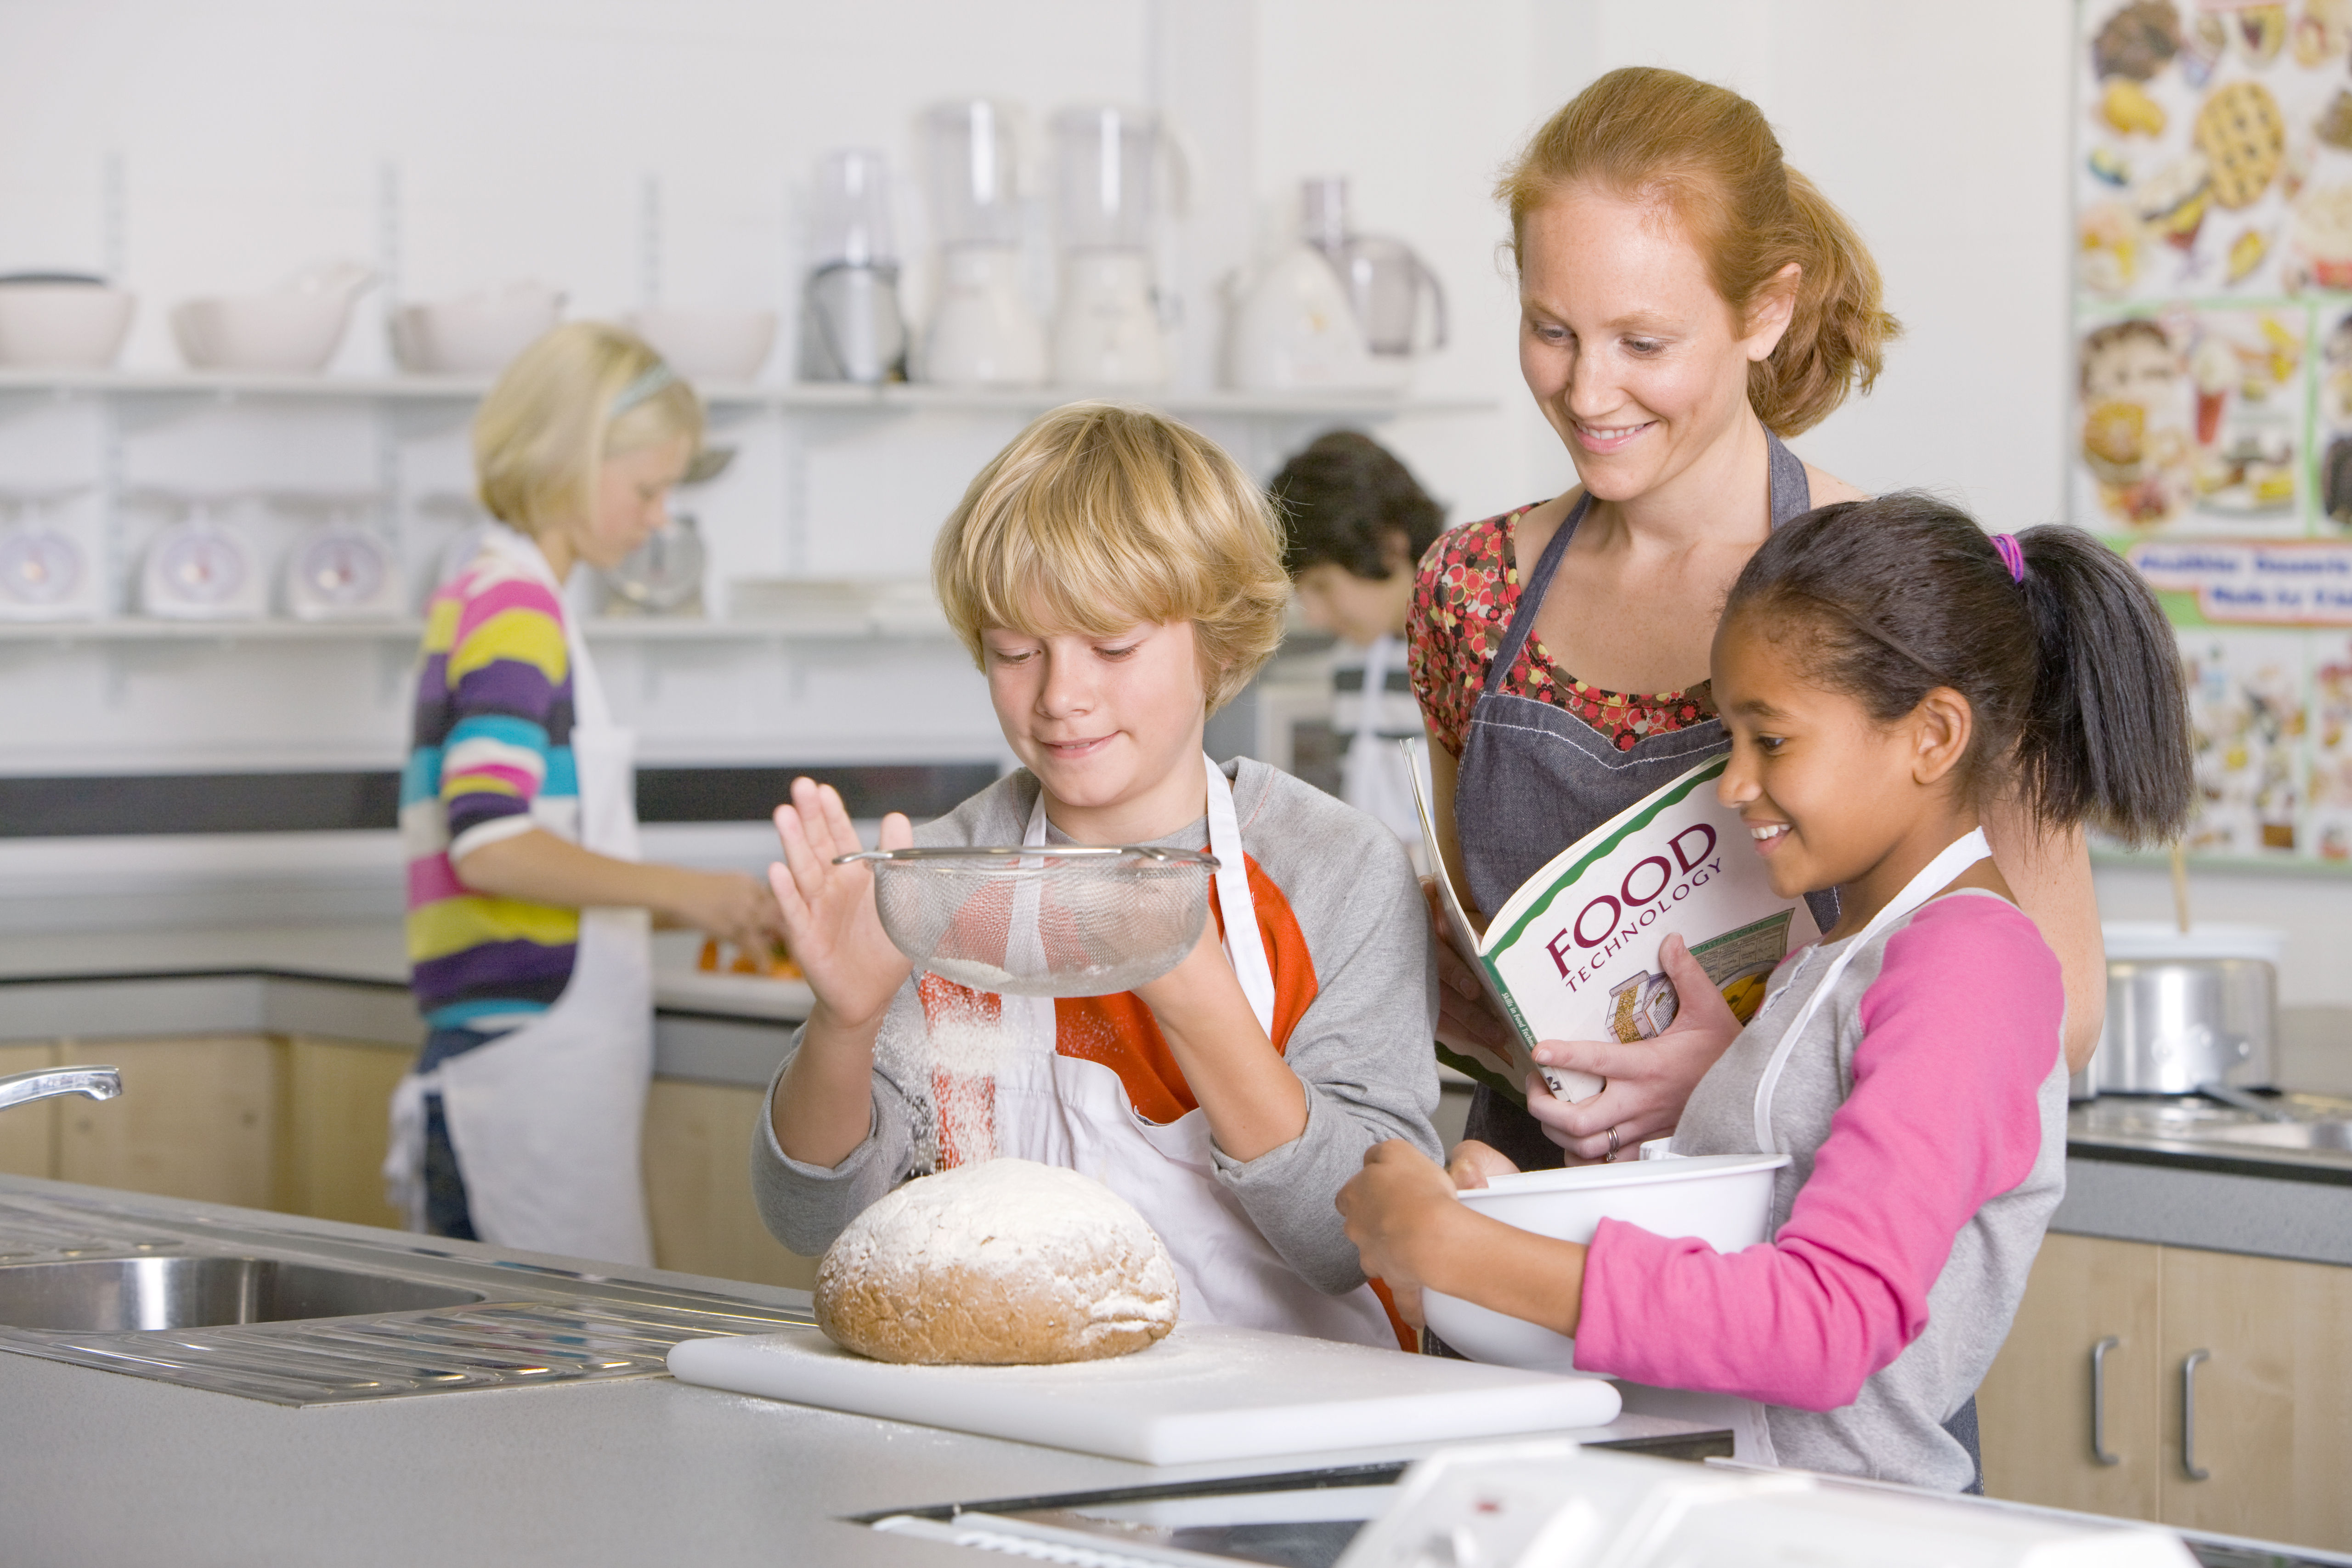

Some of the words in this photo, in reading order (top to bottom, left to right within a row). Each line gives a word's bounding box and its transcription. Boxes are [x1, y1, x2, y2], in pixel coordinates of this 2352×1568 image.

[1544, 824, 1717, 981] FOOD
[1566, 857, 1721, 993] TECHNOLOGY
[1700, 936, 1733, 952] TASTING
[1737, 923, 1764, 938] CHART
[1501, 992, 1514, 1007] Skills
[1514, 1013, 1527, 1028] Food
[1521, 1028, 1535, 1049] Techno
